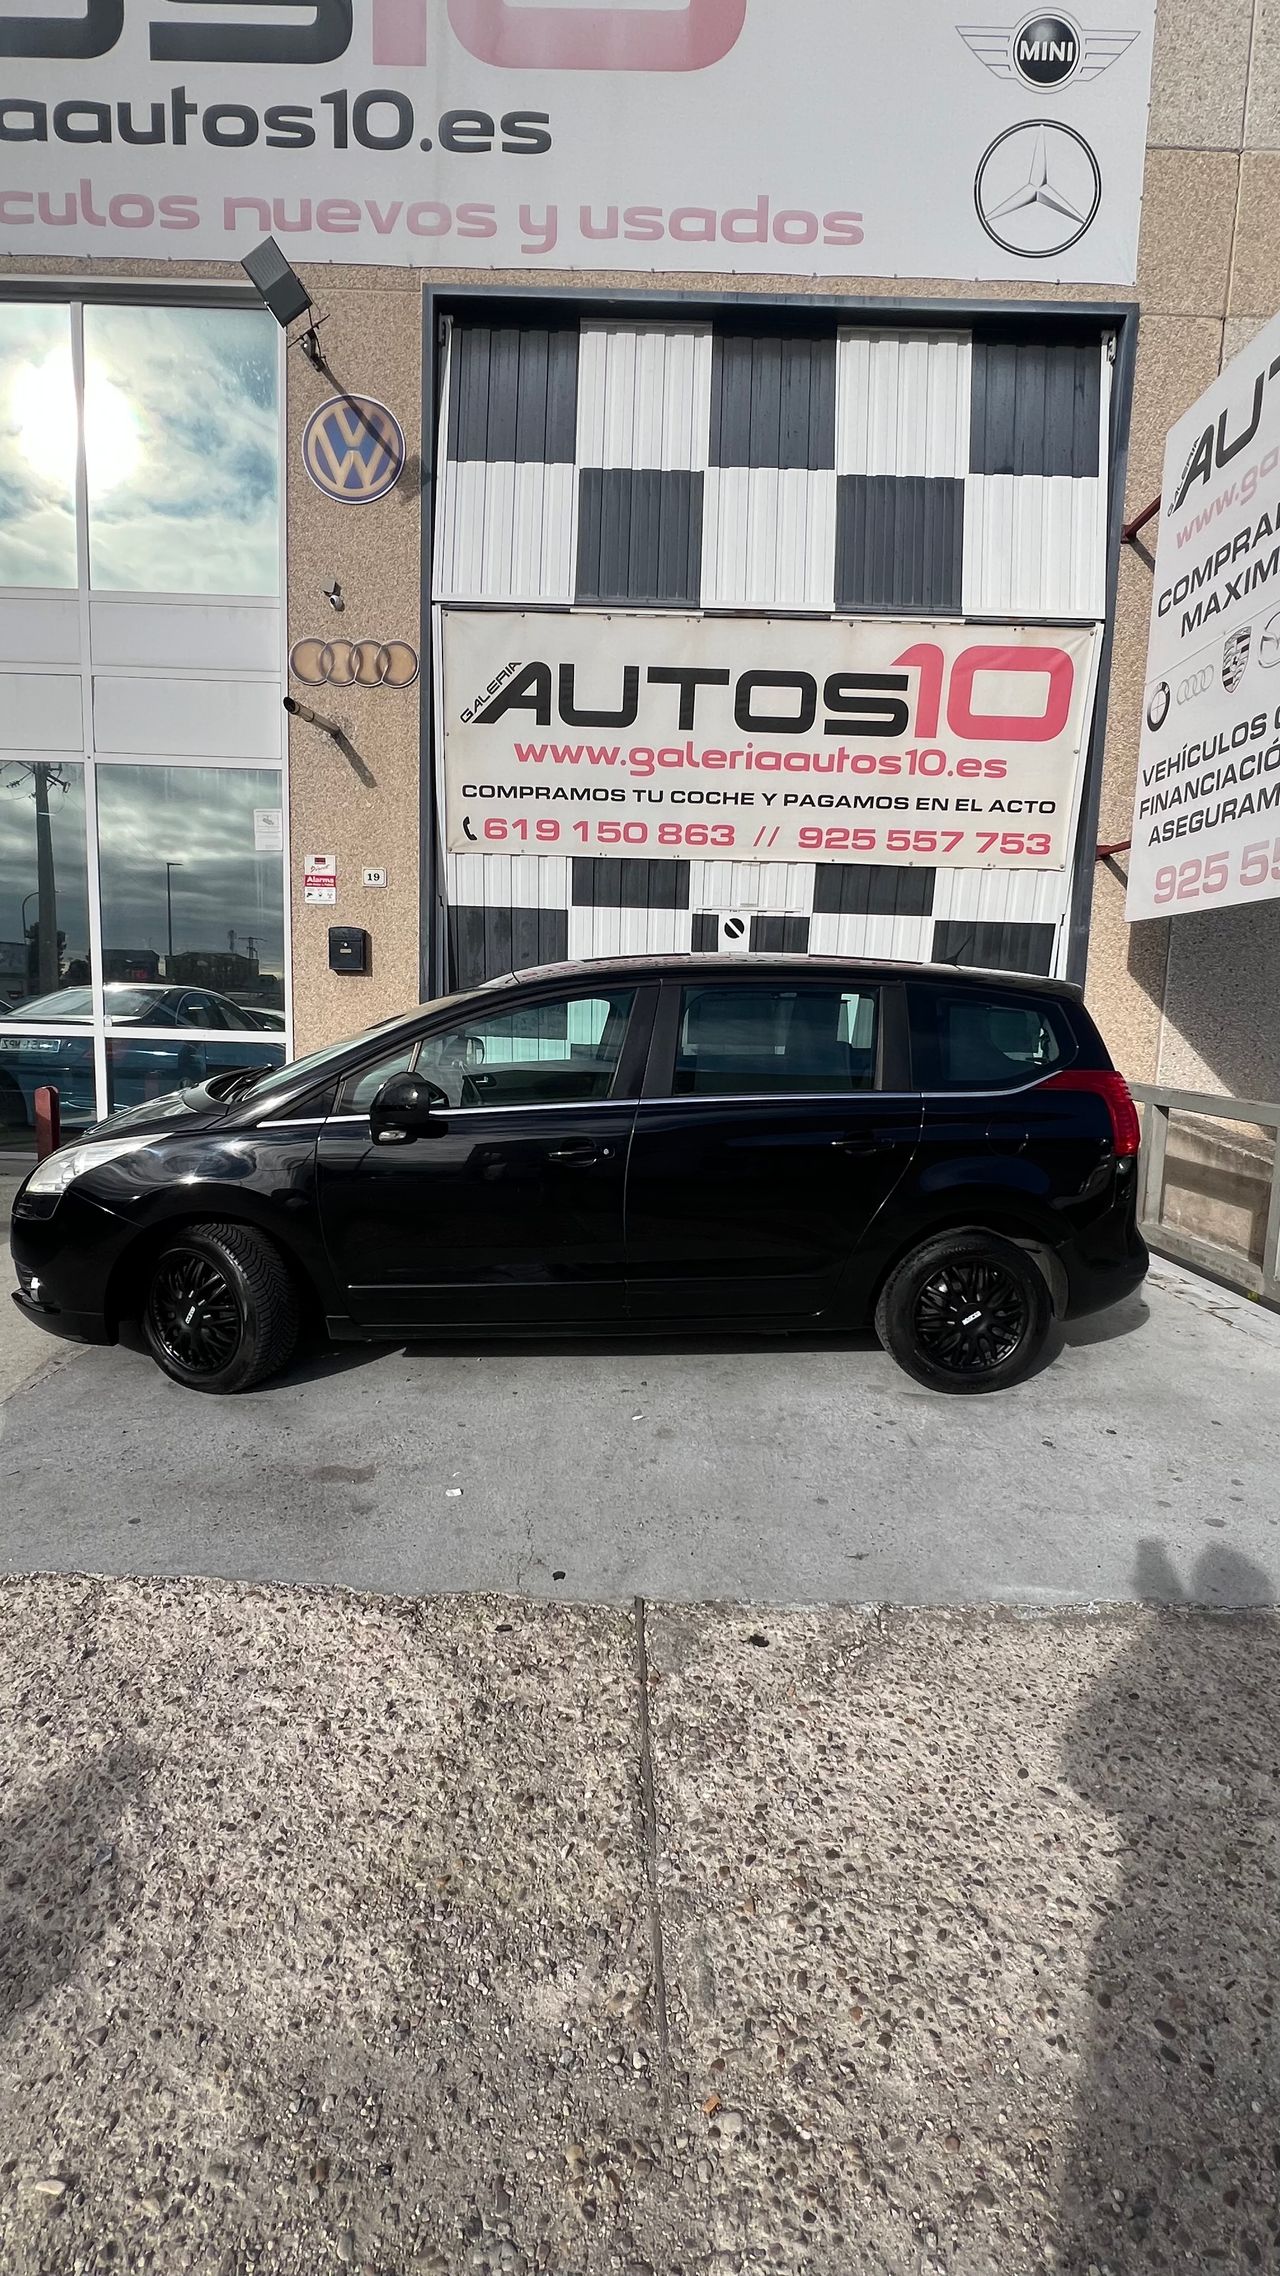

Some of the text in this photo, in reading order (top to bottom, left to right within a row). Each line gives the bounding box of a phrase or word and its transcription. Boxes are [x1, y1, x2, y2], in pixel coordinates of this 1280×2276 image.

[1020, 40, 1073, 62] MINI
[0, 85, 552, 154] aautos10.es
[0, 178, 864, 254] culos nuevos y usados
[1173, 354, 1280, 513] AU
[1158, 502, 1280, 617] COMPRA
[460, 661, 522, 724] GALERIA
[471, 643, 1075, 741] AUTOS10
[513, 740, 1008, 779] www.galeriaautos10.es
[1143, 712, 1267, 788] VEHÍCULOS
[461, 784, 1057, 814] COMPRAMOS TU COCHE Y PAGAMOS EN EL ACTO
[483, 817, 561, 842] 619
[573, 820, 649, 844] 150
[657, 822, 736, 847] 863
[798, 826, 877, 852] 925
[886, 828, 965, 854] 557
[975, 831, 1052, 857] 753
[366, 873, 381, 882] 19
[1153, 851, 1230, 904] 925
